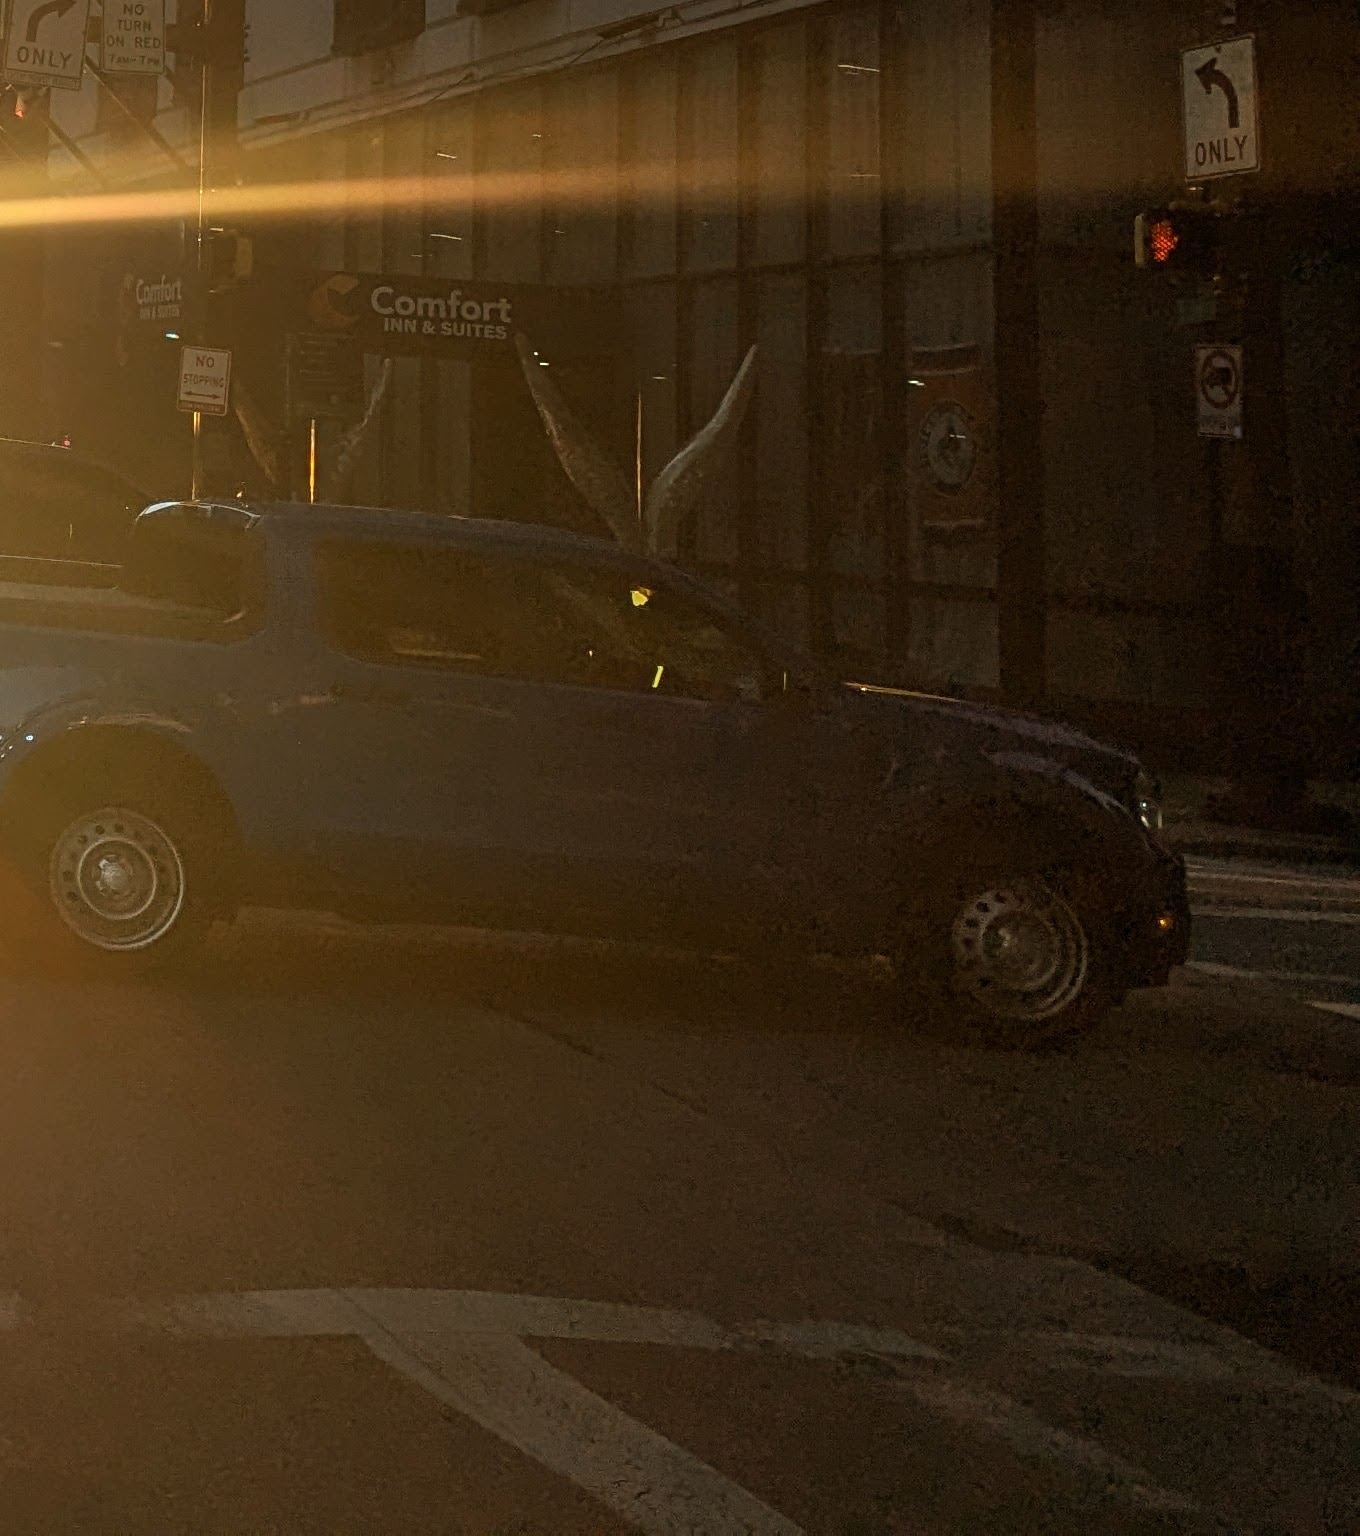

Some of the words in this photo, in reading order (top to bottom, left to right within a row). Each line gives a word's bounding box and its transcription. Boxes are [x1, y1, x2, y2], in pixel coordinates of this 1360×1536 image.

[122, 3, 145, 16] NO
[117, 18, 153, 33] TURN
[106, 35, 125, 48] ON
[134, 36, 162, 49] RED
[15, 44, 74, 71] ONLY
[1195, 134, 1249, 166] ONLY
[370, 285, 513, 325] Comfort
[383, 317, 417, 334] INN
[421, 320, 438, 336] &
[439, 321, 509, 341] SUITES
[195, 355, 215, 368] NO
[183, 372, 225, 389] STOPPING
